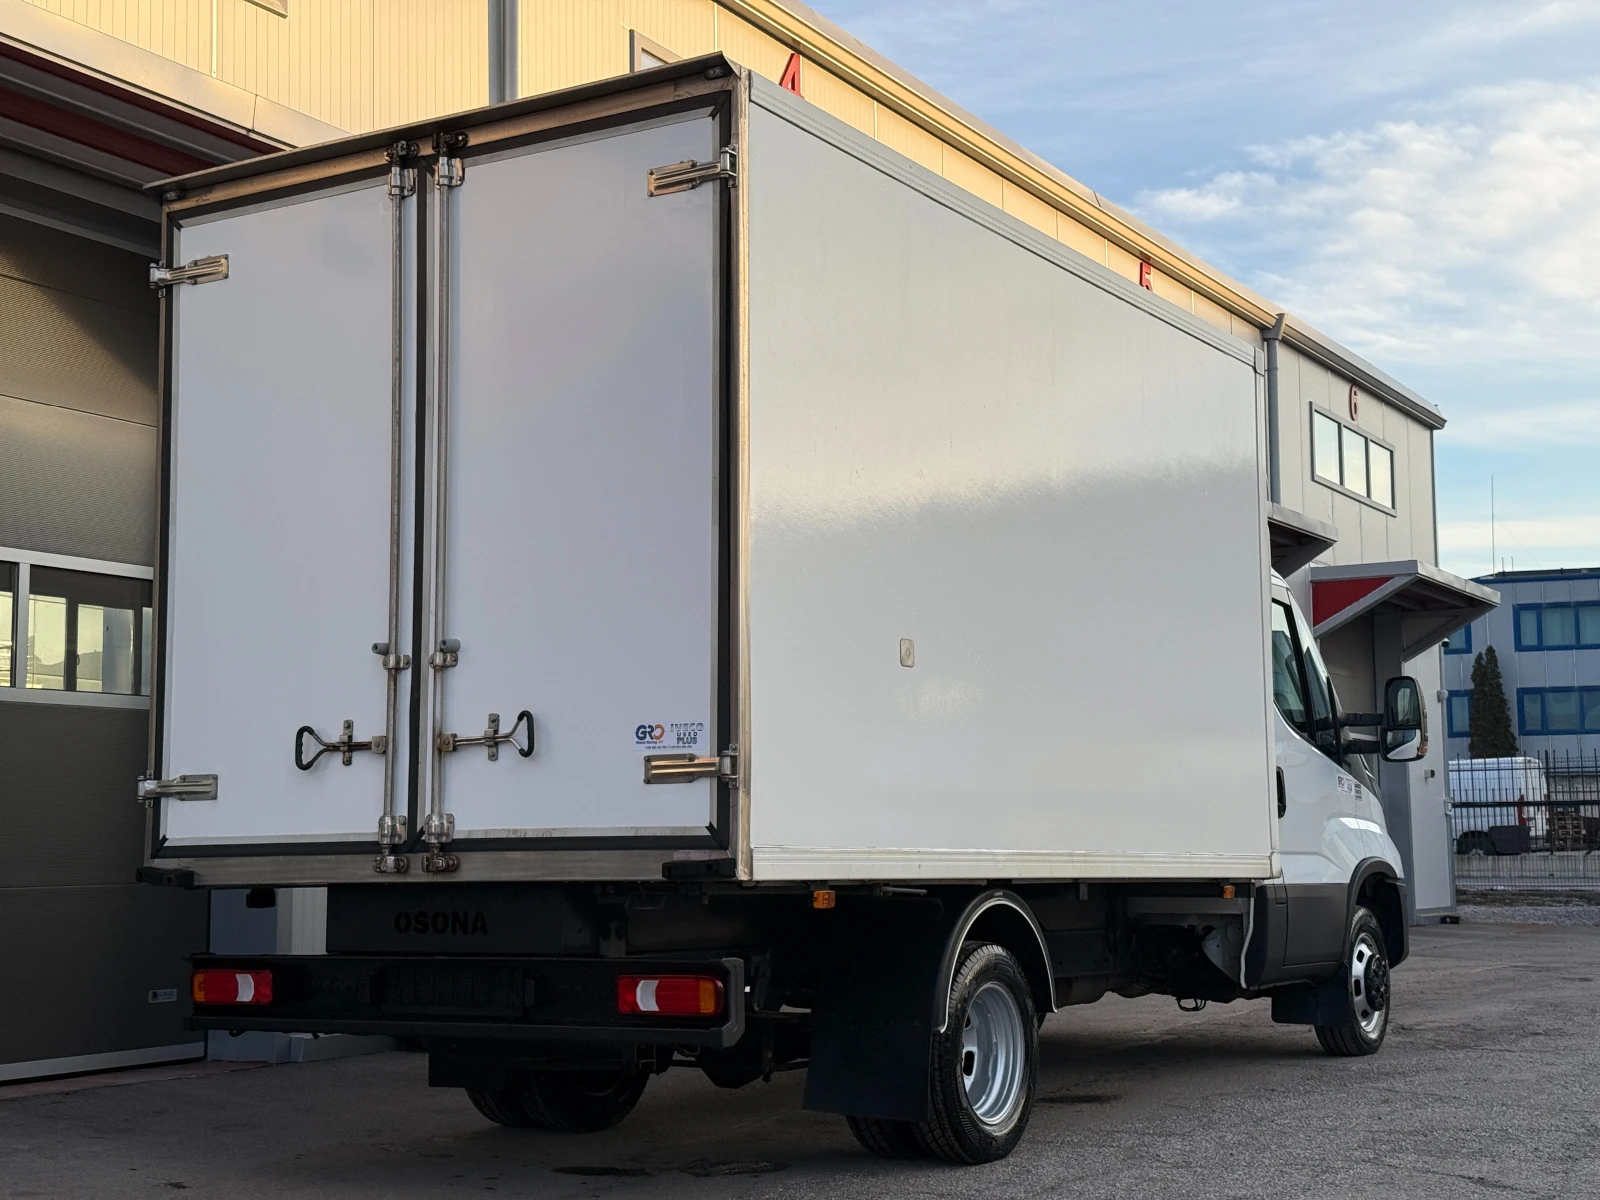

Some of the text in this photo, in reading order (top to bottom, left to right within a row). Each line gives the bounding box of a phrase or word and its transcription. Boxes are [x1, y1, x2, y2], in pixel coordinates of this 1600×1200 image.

[778, 52, 805, 100] 4
[1139, 261, 1153, 293] 5
[1349, 383, 1359, 421] 6
[635, 723, 665, 741] GRO
[670, 722, 704, 732] IVECO
[676, 737, 698, 745] PLUS
[394, 910, 489, 935] OSONA
